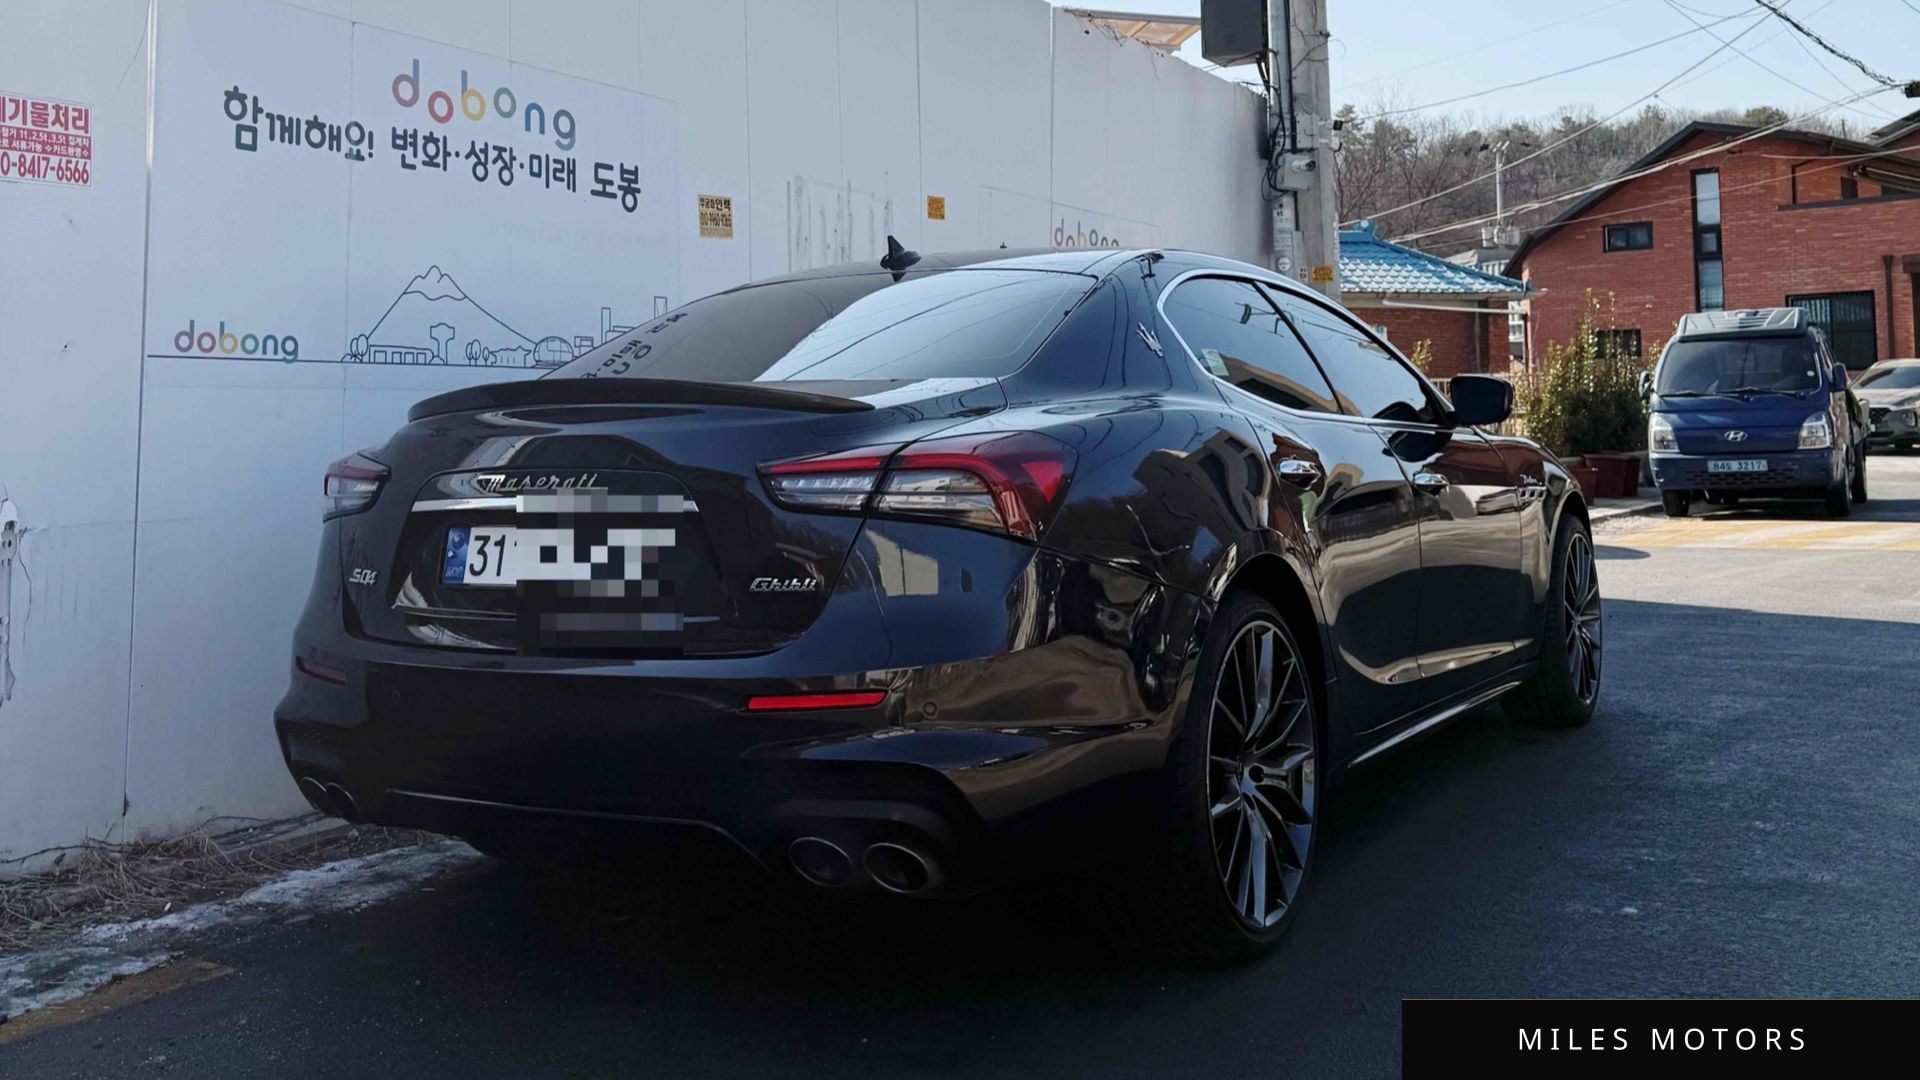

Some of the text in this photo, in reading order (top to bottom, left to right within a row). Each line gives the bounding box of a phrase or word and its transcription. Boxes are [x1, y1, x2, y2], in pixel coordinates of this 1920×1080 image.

[392, 58, 576, 151] dobong
[223, 85, 374, 162] 함께해요!
[590, 161, 641, 213] 도봉
[174, 319, 299, 364] dobong
[476, 472, 599, 492] Maserati
[749, 577, 818, 592] Ghibli
